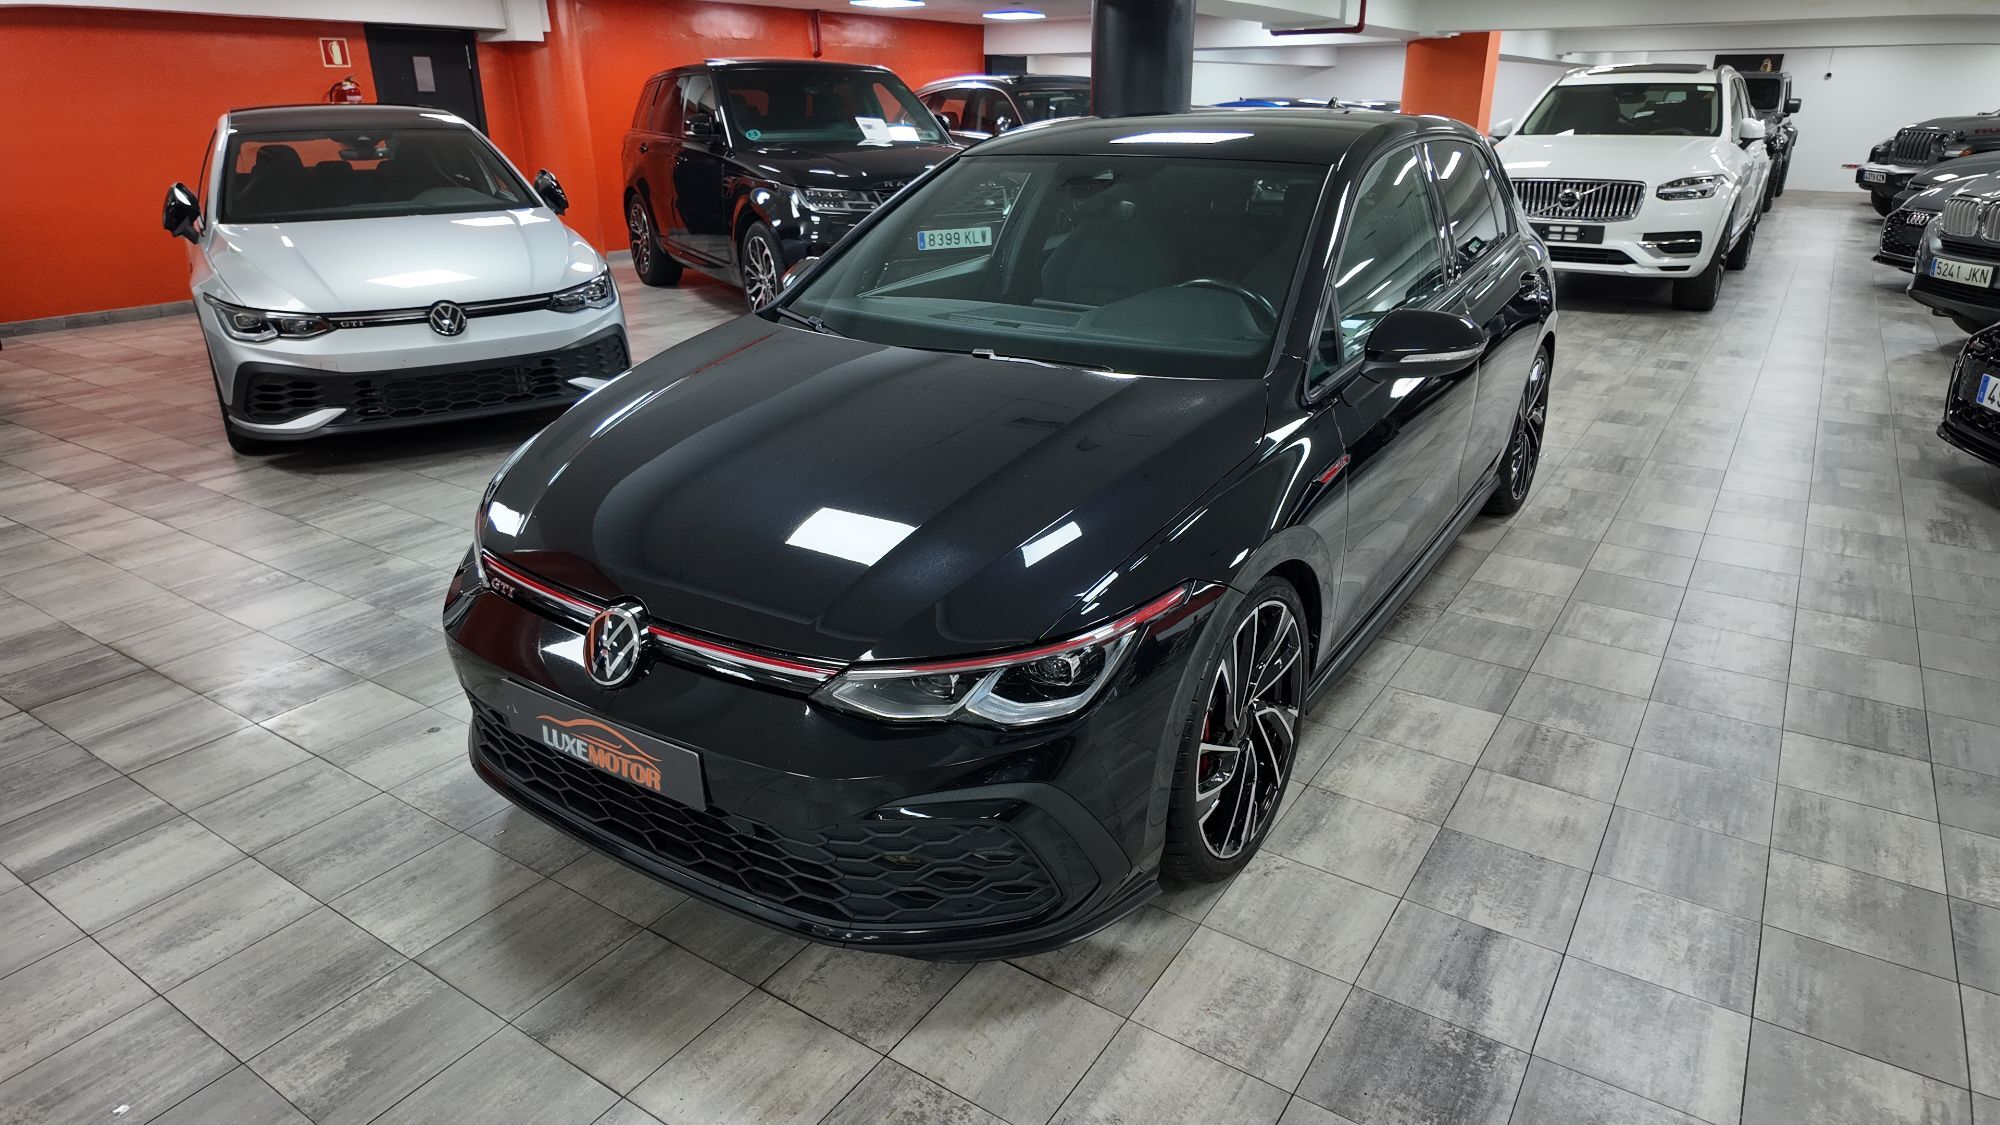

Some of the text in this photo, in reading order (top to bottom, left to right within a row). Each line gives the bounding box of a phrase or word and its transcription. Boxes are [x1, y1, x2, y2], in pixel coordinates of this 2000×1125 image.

[928, 233, 960, 247] 8399
[1936, 262, 1989, 284] 5241 JKN
[340, 320, 364, 328] GTI
[491, 577, 516, 599] GTI
[542, 724, 661, 792] LUXEMOTOR
